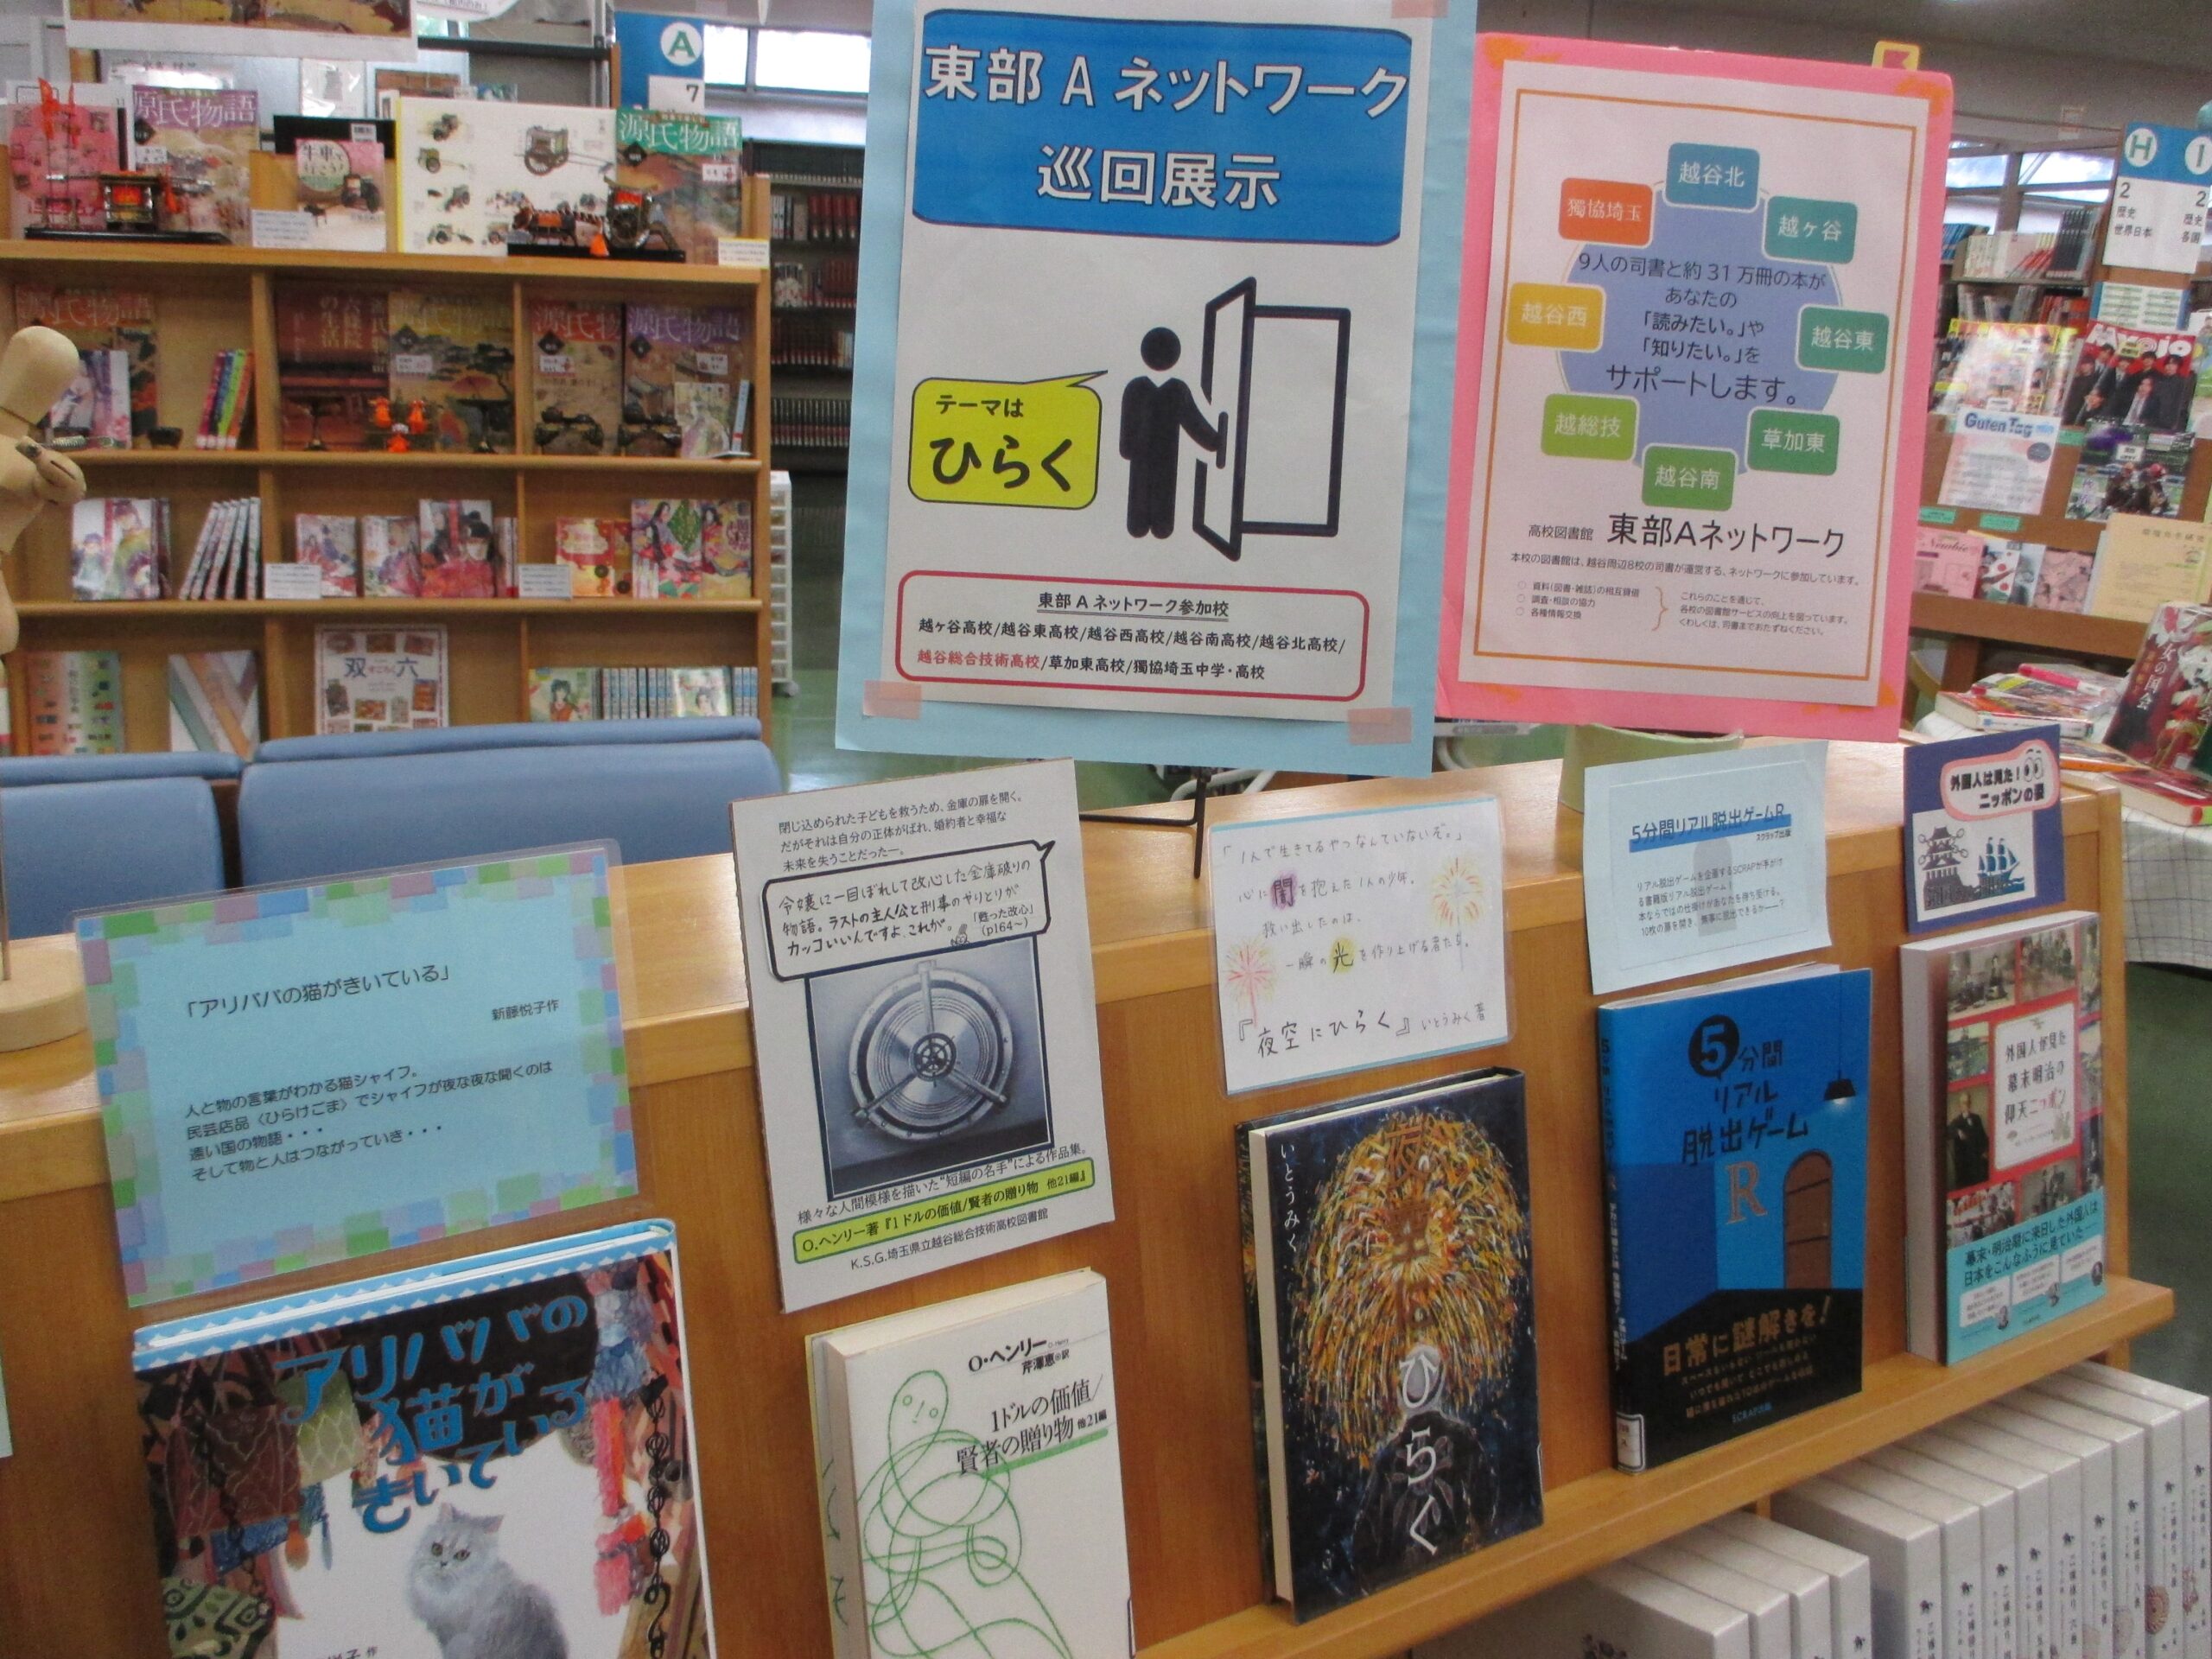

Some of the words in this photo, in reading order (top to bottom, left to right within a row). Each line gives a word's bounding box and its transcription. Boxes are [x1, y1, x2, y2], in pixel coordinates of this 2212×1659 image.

[668, 31, 695, 58] A
[686, 85, 699, 102] 7
[925, 45, 1041, 105] 東部
[1061, 55, 1095, 107] A
[1114, 56, 1410, 118] ネットワーク
[2130, 135, 2153, 160] H
[2196, 144, 2205, 168] I
[1037, 144, 1281, 210] 巡回展示
[1679, 162, 1745, 188] 越谷北
[2120, 181, 2131, 199] 2
[2196, 191, 2207, 207] 2
[1567, 198, 1642, 222] 獨協埼玉
[2117, 206, 2136, 219] 歴史
[2183, 213, 2202, 226] 歴史
[1777, 215, 1842, 242] 越ヶ谷
[1665, 287, 1738, 308] あなたの
[1522, 302, 1587, 327] 越谷西
[1644, 311, 1764, 338] 「読みたい。」や
[1643, 339, 1762, 365] 「知りたい。」を
[1811, 326, 1875, 352] 越谷東
[1605, 364, 1796, 406] サポートします。
[935, 393, 1025, 418] テーマは
[1554, 412, 1621, 439] 越総技
[1965, 412, 2007, 433] Guten
[1762, 428, 1825, 454] 草加東
[929, 435, 1073, 493] ひらく
[1655, 464, 1721, 491] 越谷南
[1529, 524, 1594, 543] 高校図書館
[1607, 512, 1846, 558] 東部Aネットワーク
[1039, 592, 1071, 609] 東部
[1076, 594, 1089, 608] A
[1093, 594, 1229, 617] ネットワーク参加校
[779, 791, 1022, 834] 閉じ込められた子どもを救うため、金庫の扉を開く。
[187, 963, 451, 1019] 「アリババの猫がきいている」
[491, 998, 560, 1022] 新藤悦子作
[2007, 1060, 2064, 1093] 幕末明治の
[185, 1065, 419, 1119] 人と物の言葉がわかる猫シャイフ。
[1715, 1079, 1779, 1115] リアル
[1681, 1109, 1808, 1166] 脱出ゲーム
[1281, 1143, 1300, 1252] いとうみく
[1726, 1160, 1768, 1225] R
[372, 1363, 533, 1465] 猫が
[957, 1415, 1074, 1476] 賢者の贈り物
